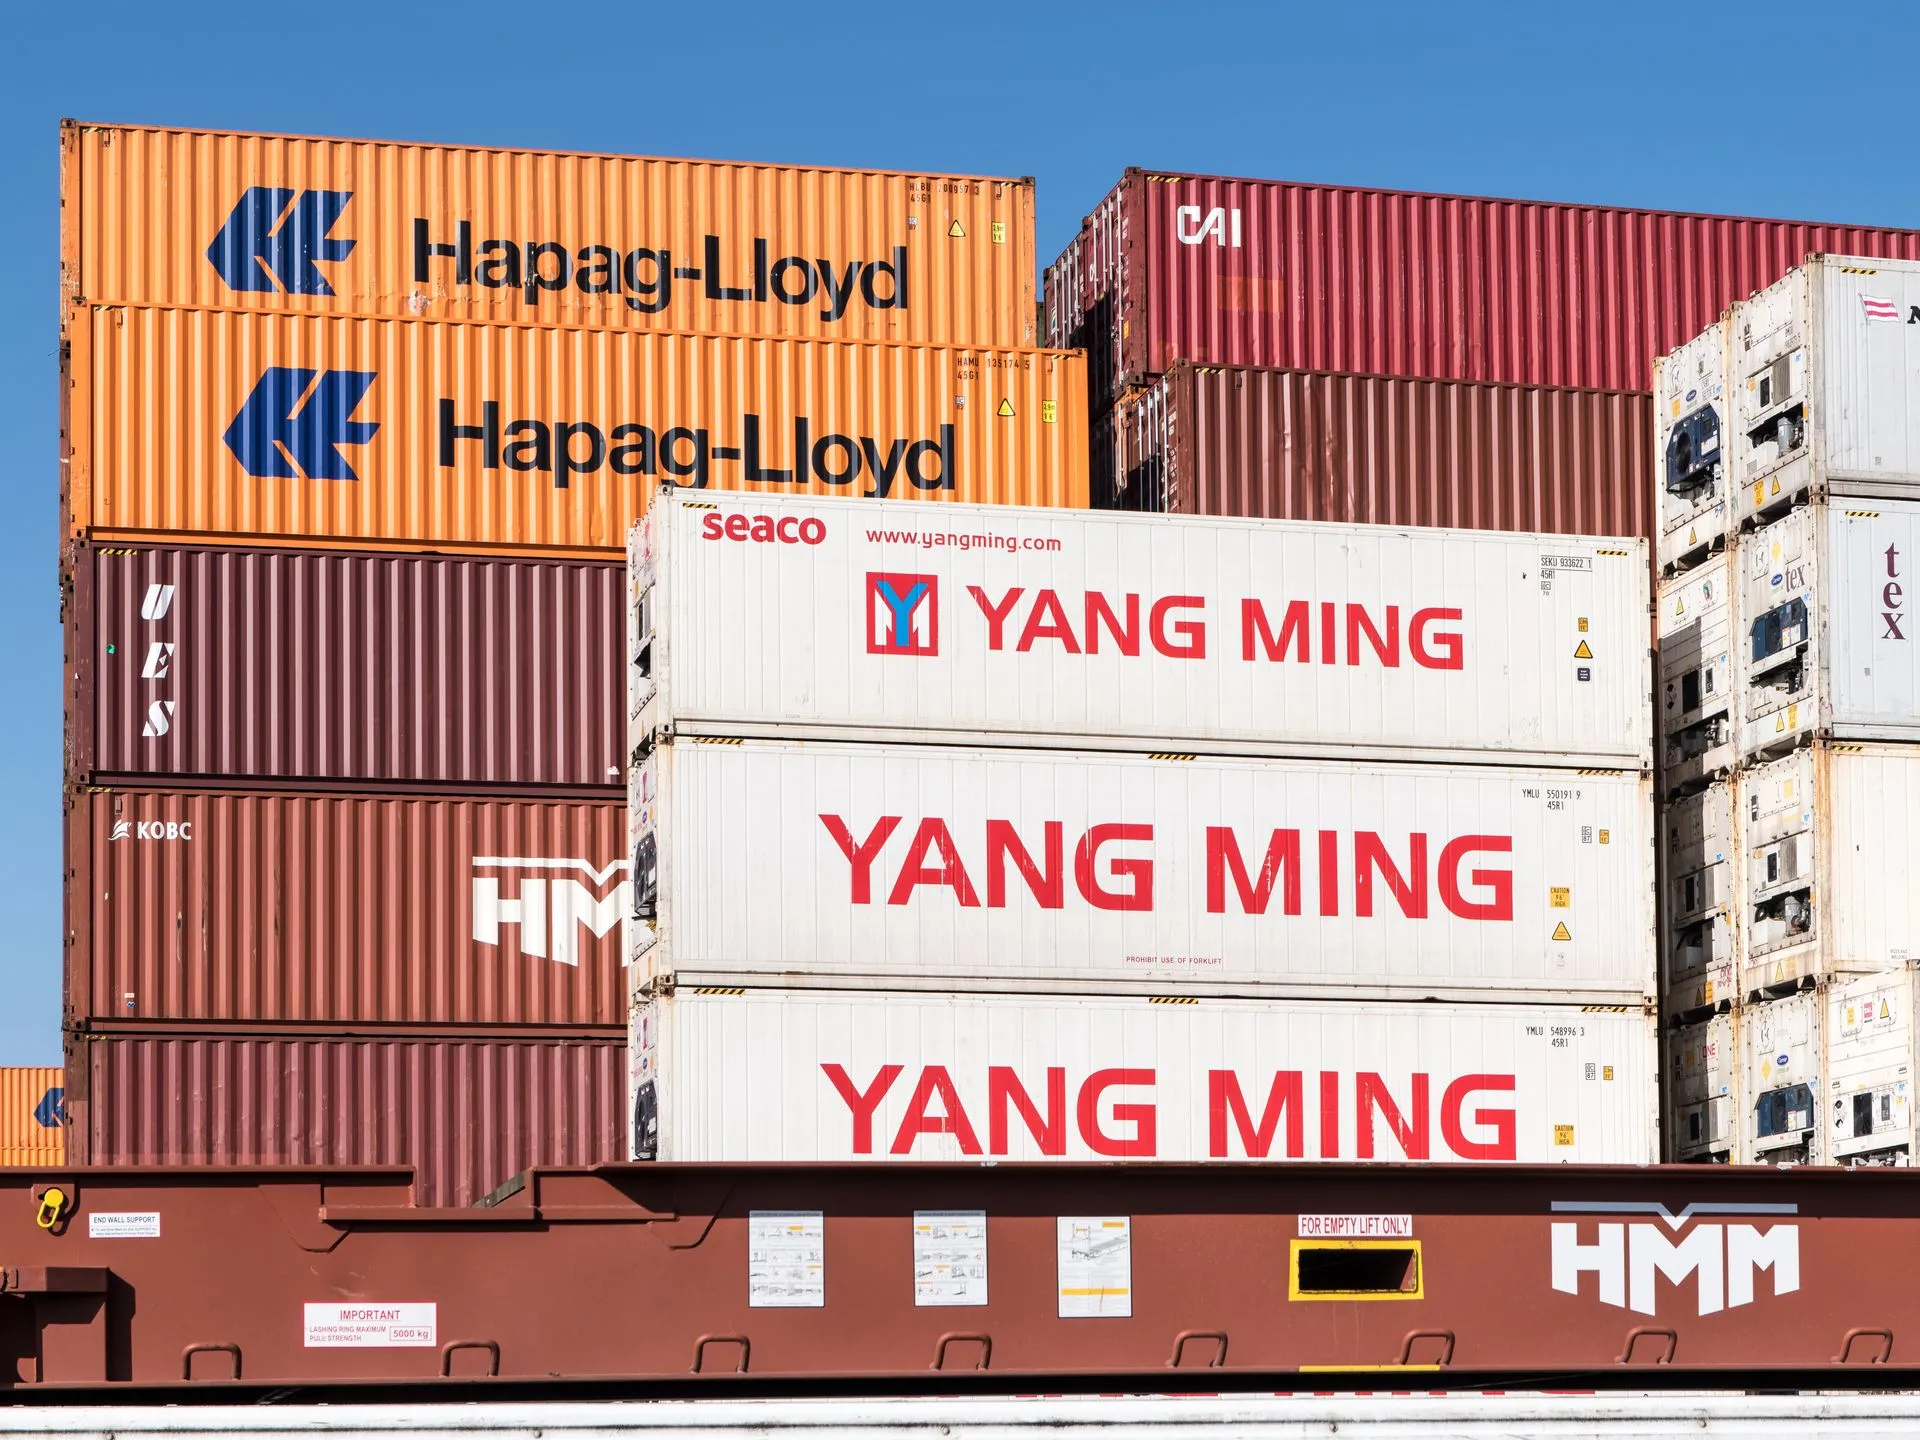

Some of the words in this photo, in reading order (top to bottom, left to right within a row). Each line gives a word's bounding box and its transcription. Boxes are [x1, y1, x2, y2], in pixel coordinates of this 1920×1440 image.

[910, 194, 931, 203] 45G1
[1177, 205, 1242, 248] CAI
[413, 217, 908, 322] Hapag-Lloyd
[957, 357, 979, 367] HAMU
[988, 359, 1019, 368] 135174
[1025, 360, 1030, 370] 5
[957, 371, 979, 380] 45G1
[439, 398, 956, 497] Hapag-Lloyd
[701, 512, 827, 546] seaco
[865, 527, 1062, 554] www.yangming.com
[1540, 557, 1558, 567] SEKU
[1560, 558, 1584, 569] 933622
[1588, 560, 1592, 569] 1
[1540, 569, 1556, 580] 45R1
[1785, 564, 1806, 593] tex
[1880, 542, 1907, 640] tex
[966, 585, 1206, 660] YANG
[1241, 598, 1464, 671] MING
[1522, 789, 1540, 799] YMLU
[1547, 789, 1573, 800] 550191
[1576, 791, 1581, 800] 9
[1547, 800, 1565, 811] 45R1
[137, 820, 192, 841] KOBC
[818, 813, 1153, 912] YANG
[1206, 826, 1514, 922] MING
[472, 877, 630, 968] HM
[1160, 956, 1174, 964] USE
[1189, 957, 1222, 965] FORKLIFT
[1526, 1026, 1543, 1036] YMLU
[1550, 1026, 1577, 1036] 548996
[1580, 1027, 1585, 1037] 3
[1551, 1038, 1569, 1048] 45R1
[820, 1063, 1157, 1158] YANG
[1208, 1069, 1516, 1161] MING
[94, 1216, 107, 1224] END
[1301, 1217, 1322, 1234] FOR
[1324, 1217, 1358, 1234] EMPTY
[1360, 1217, 1380, 1234] LIFT
[1382, 1217, 1409, 1234] ONLY
[1551, 1201, 1800, 1316] HMM
[340, 1309, 401, 1320] IMPORTANT
[393, 1329, 415, 1338] 5000
[417, 1329, 429, 1339] kg
